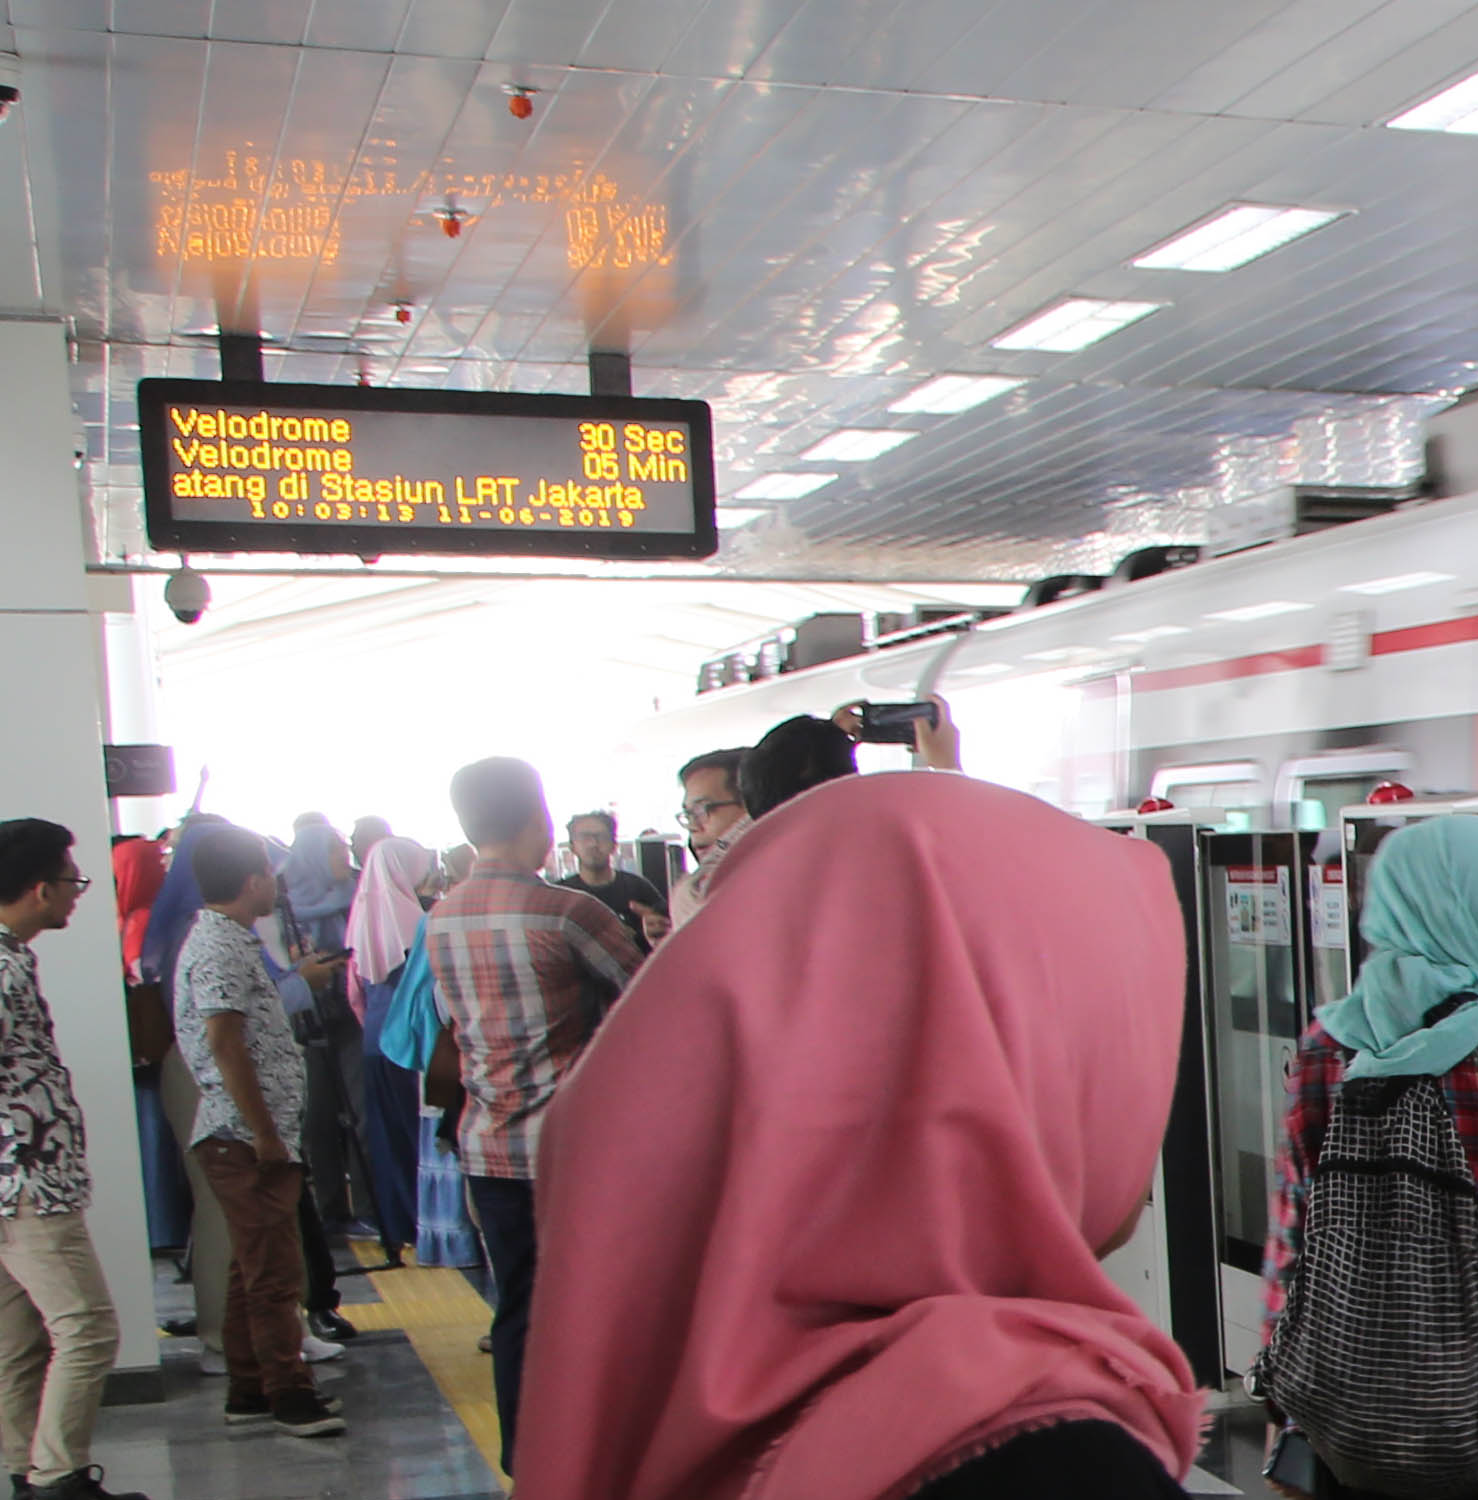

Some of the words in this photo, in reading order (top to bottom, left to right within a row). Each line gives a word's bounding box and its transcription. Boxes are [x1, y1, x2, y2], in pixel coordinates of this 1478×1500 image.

[170, 407, 352, 443] Velodrome
[578, 422, 616, 452] 30
[623, 423, 686, 455] Sec
[172, 438, 353, 472] Velodrome
[582, 452, 620, 480] 05
[627, 453, 688, 483] Min
[172, 469, 268, 502] atang
[278, 472, 310, 501] di
[320, 472, 445, 504] Stasiun
[454, 476, 521, 506] LRT
[528, 478, 647, 510] Jakarta
[251, 501, 416, 524] 10:03:13
[438, 505, 636, 528] 11-06-2019
